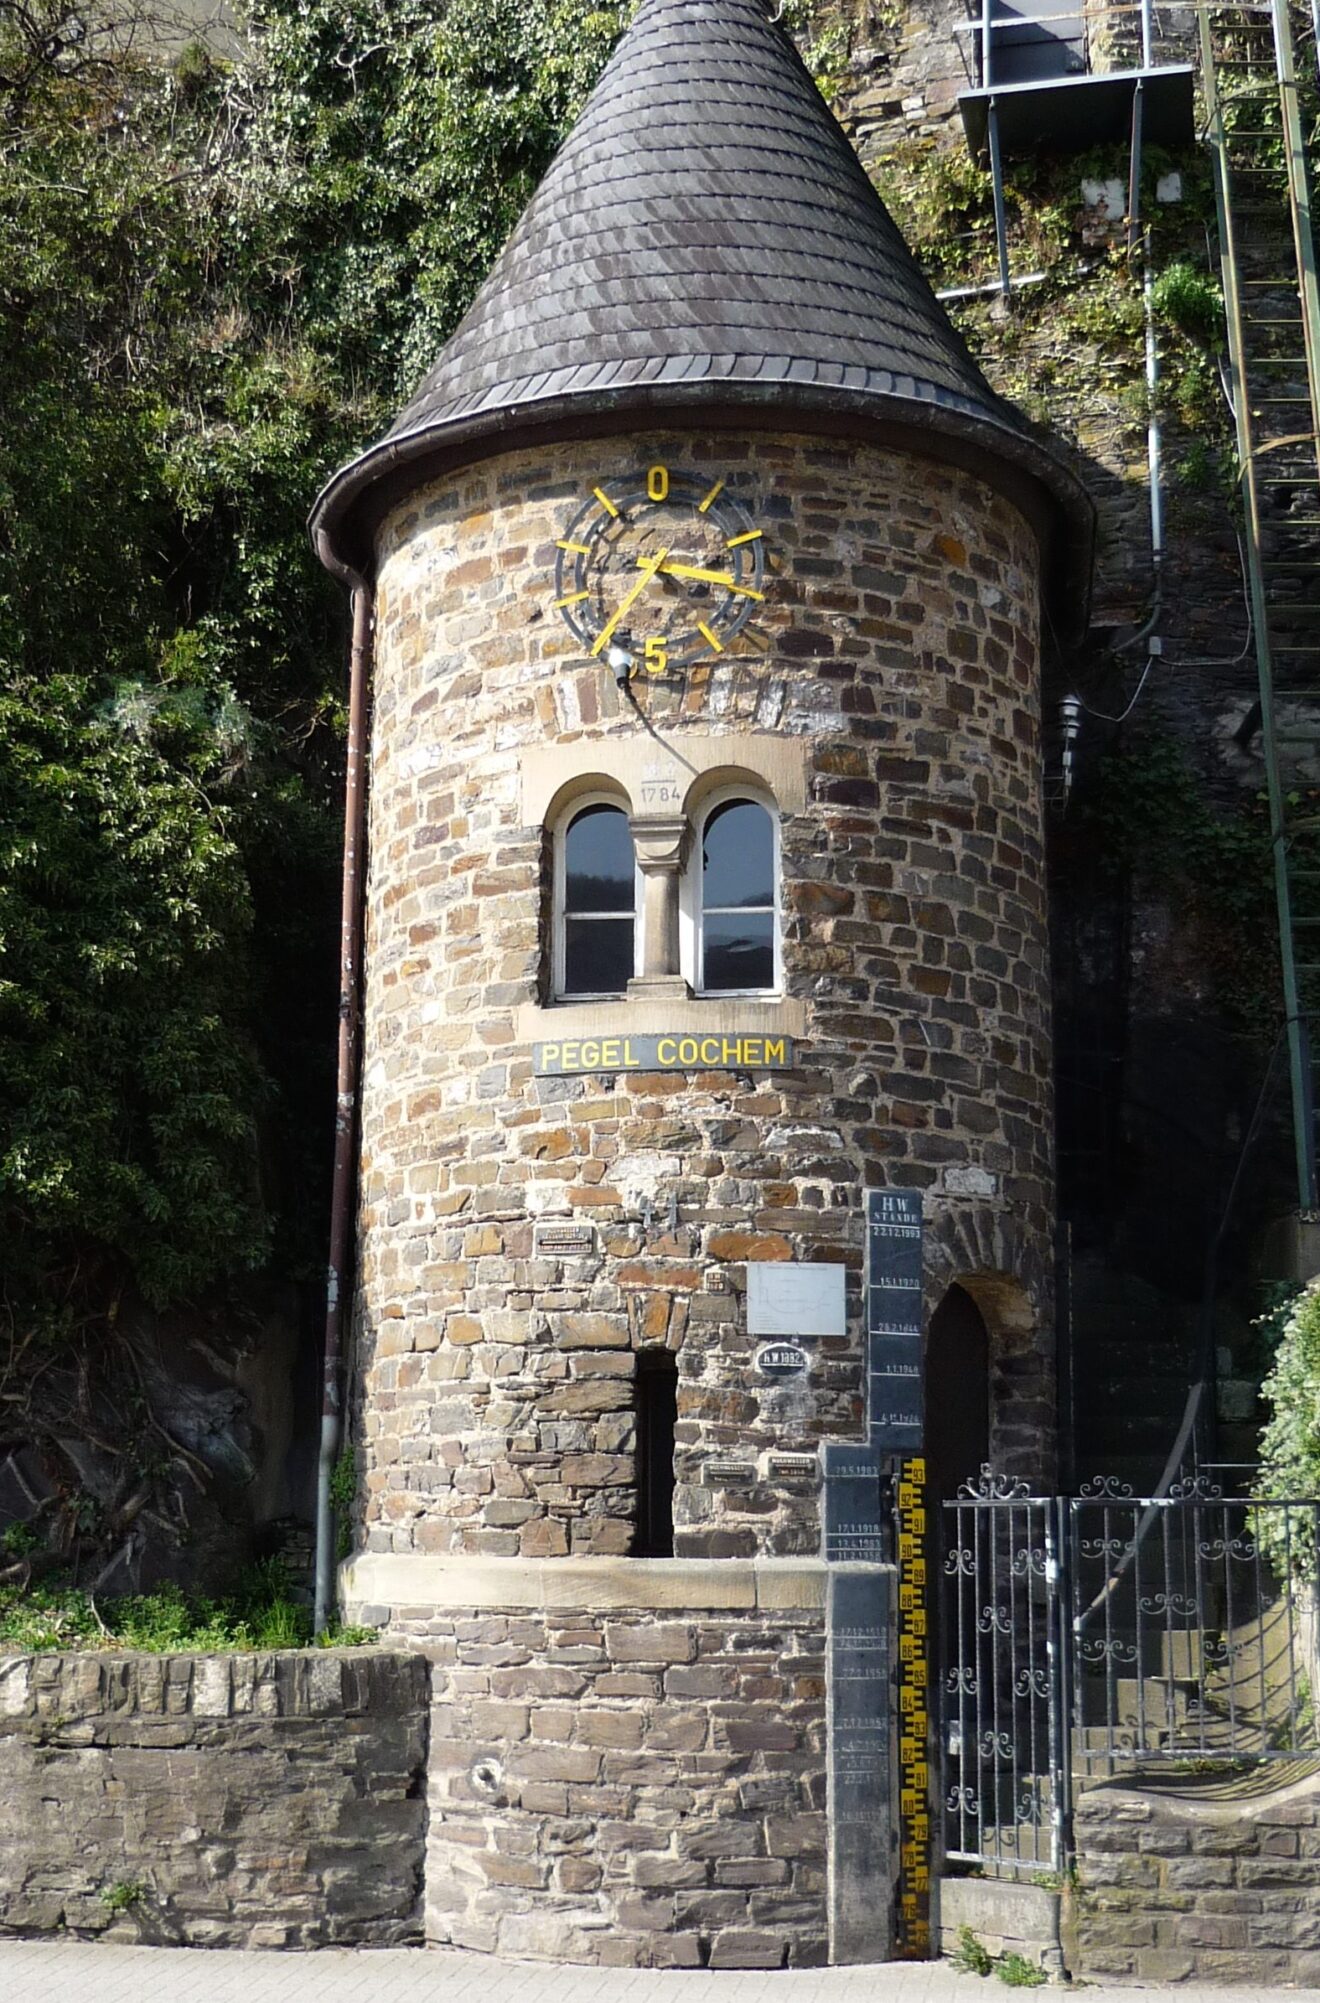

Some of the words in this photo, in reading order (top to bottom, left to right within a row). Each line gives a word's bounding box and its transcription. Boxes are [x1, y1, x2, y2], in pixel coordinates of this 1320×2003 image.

[647, 465, 669, 502] 0
[645, 637, 667, 673] 5
[641, 786, 681, 802] 1784
[542, 1040, 640, 1071] PEGEL
[657, 1038, 784, 1065] COCHEM
[882, 1196, 909, 1212] HW
[914, 1468, 923, 1481] 93
[902, 1493, 912, 1507] 92
[913, 1518, 923, 1532] 91
[902, 1544, 912, 1557] 90
[913, 1569, 923, 1582] 89
[902, 1594, 912, 1607] 88
[914, 1619, 924, 1632] 87
[902, 1645, 912, 1658] 86
[914, 1670, 924, 1683] 85
[902, 1696, 912, 1709] 84
[915, 1722, 925, 1735] 83
[903, 1747, 913, 1760] 82
[915, 1773, 925, 1786] 81
[903, 1800, 913, 1813] 80
